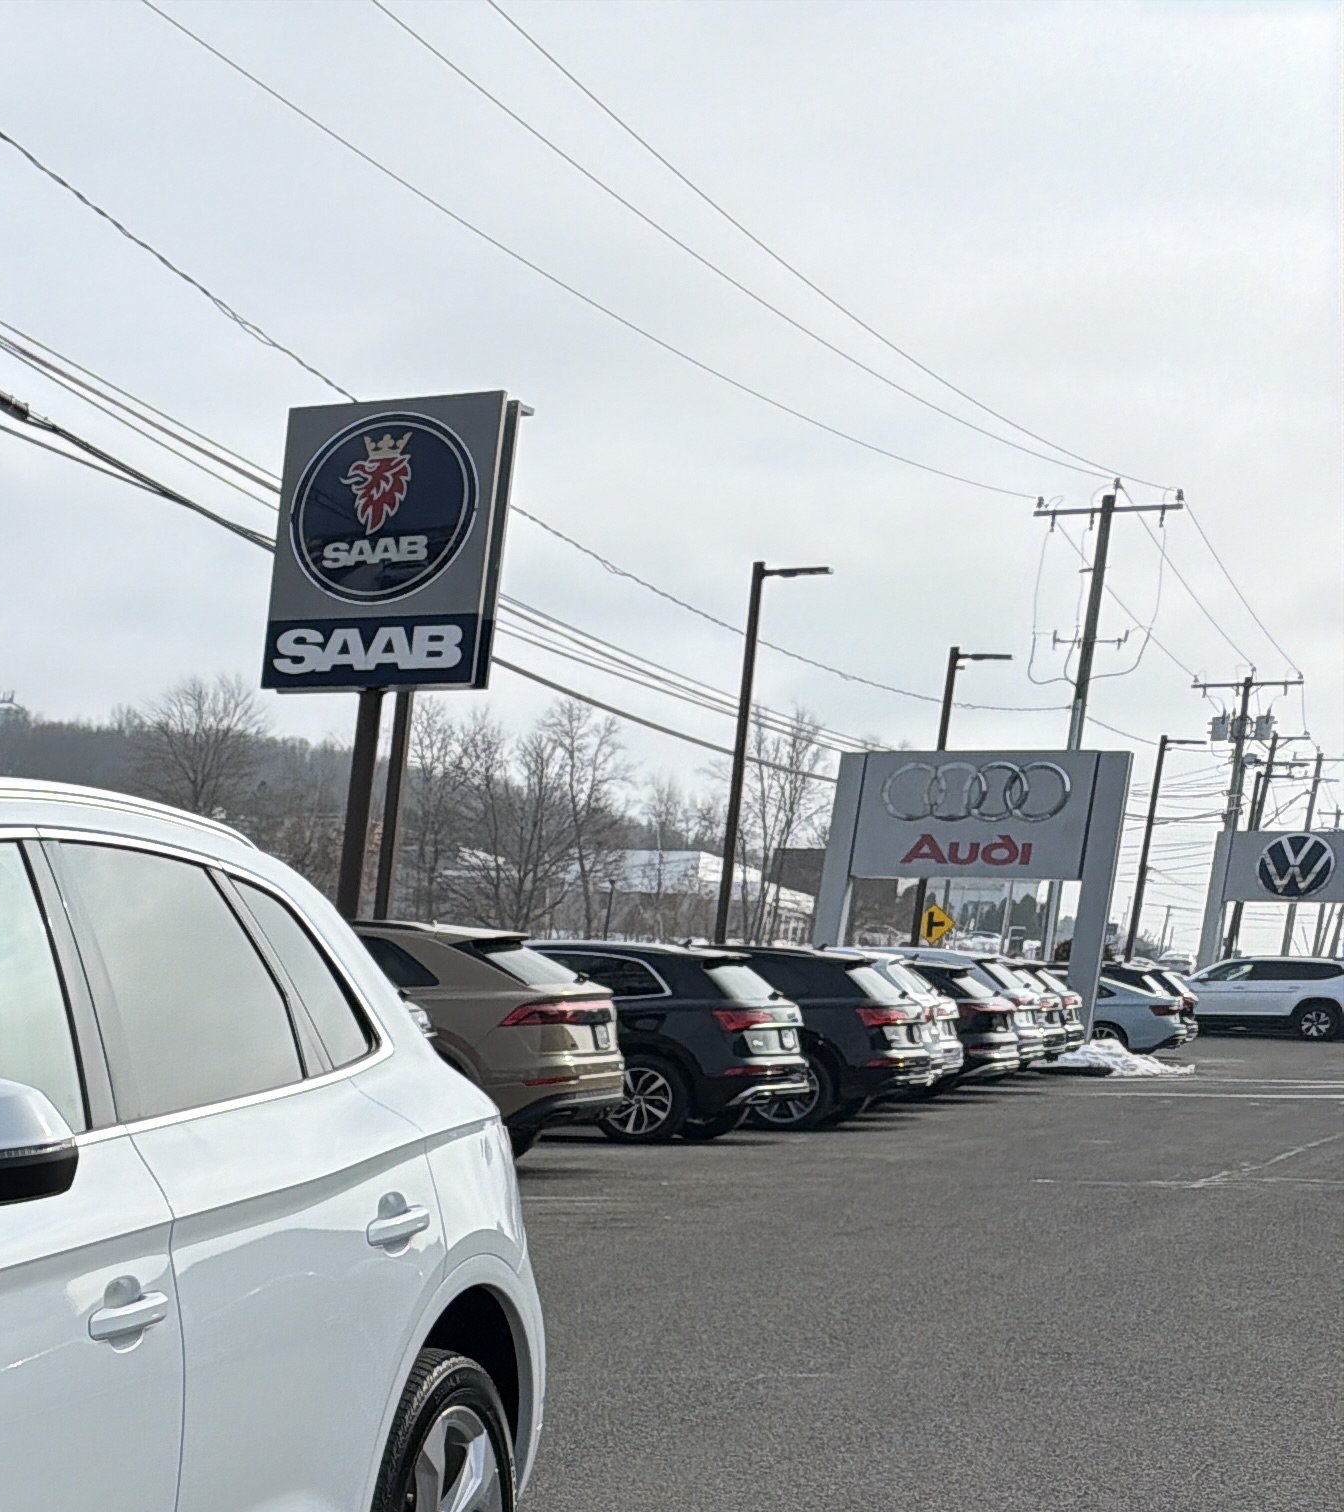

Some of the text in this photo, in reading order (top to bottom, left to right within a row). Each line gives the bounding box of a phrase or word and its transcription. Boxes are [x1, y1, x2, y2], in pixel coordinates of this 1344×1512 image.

[322, 535, 428, 569] SAAB
[273, 624, 463, 675] SAAB
[899, 833, 1033, 866] Audi
